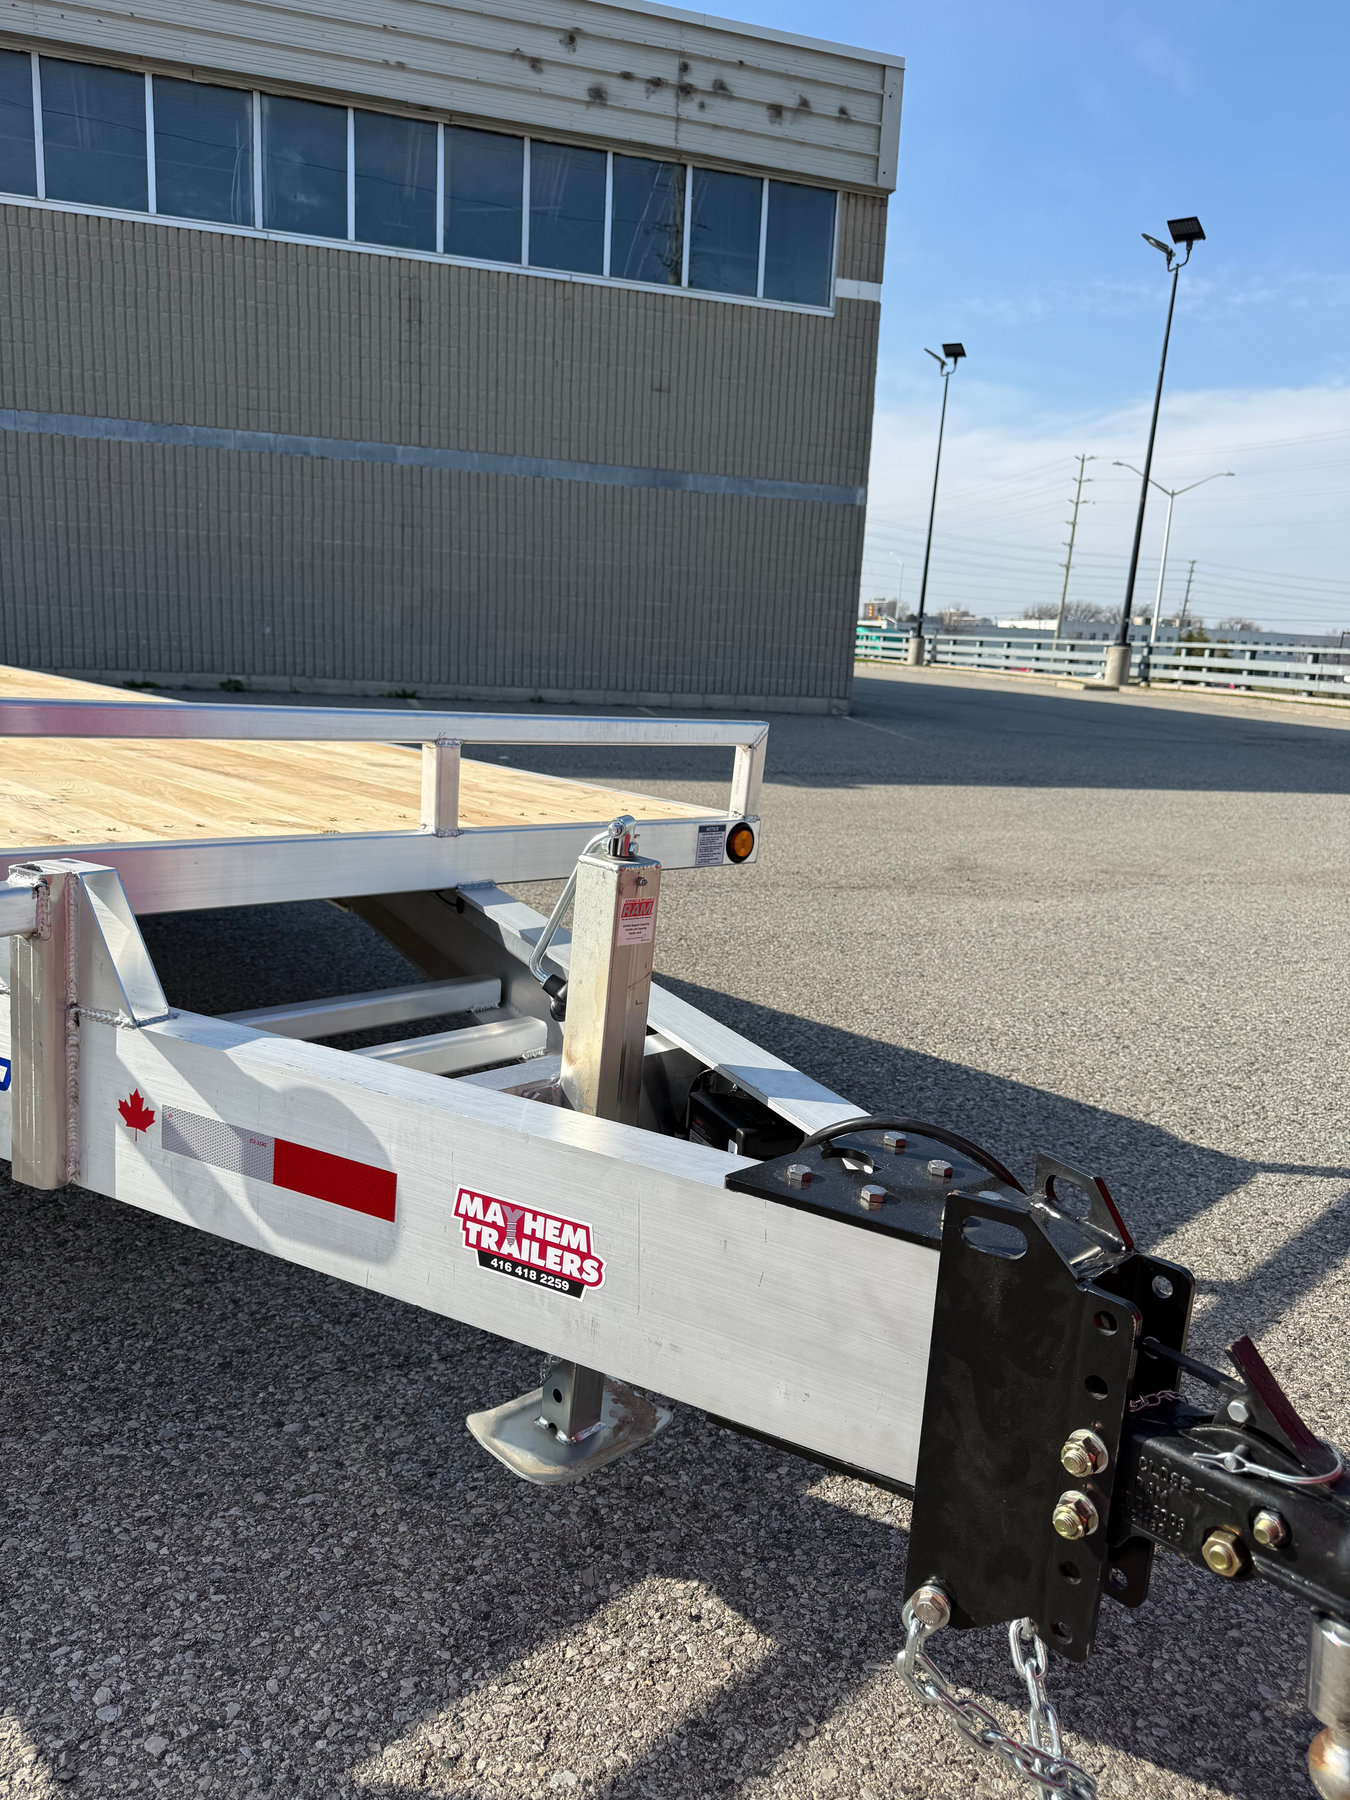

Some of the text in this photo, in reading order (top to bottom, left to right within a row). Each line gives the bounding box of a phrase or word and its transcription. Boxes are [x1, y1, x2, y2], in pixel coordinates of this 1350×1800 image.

[622, 903, 652, 916] RAM
[458, 1192, 588, 1253] MAYHEM
[466, 1220, 599, 1284] TRAILERS
[490, 1258, 570, 1291] 416 418 2259
